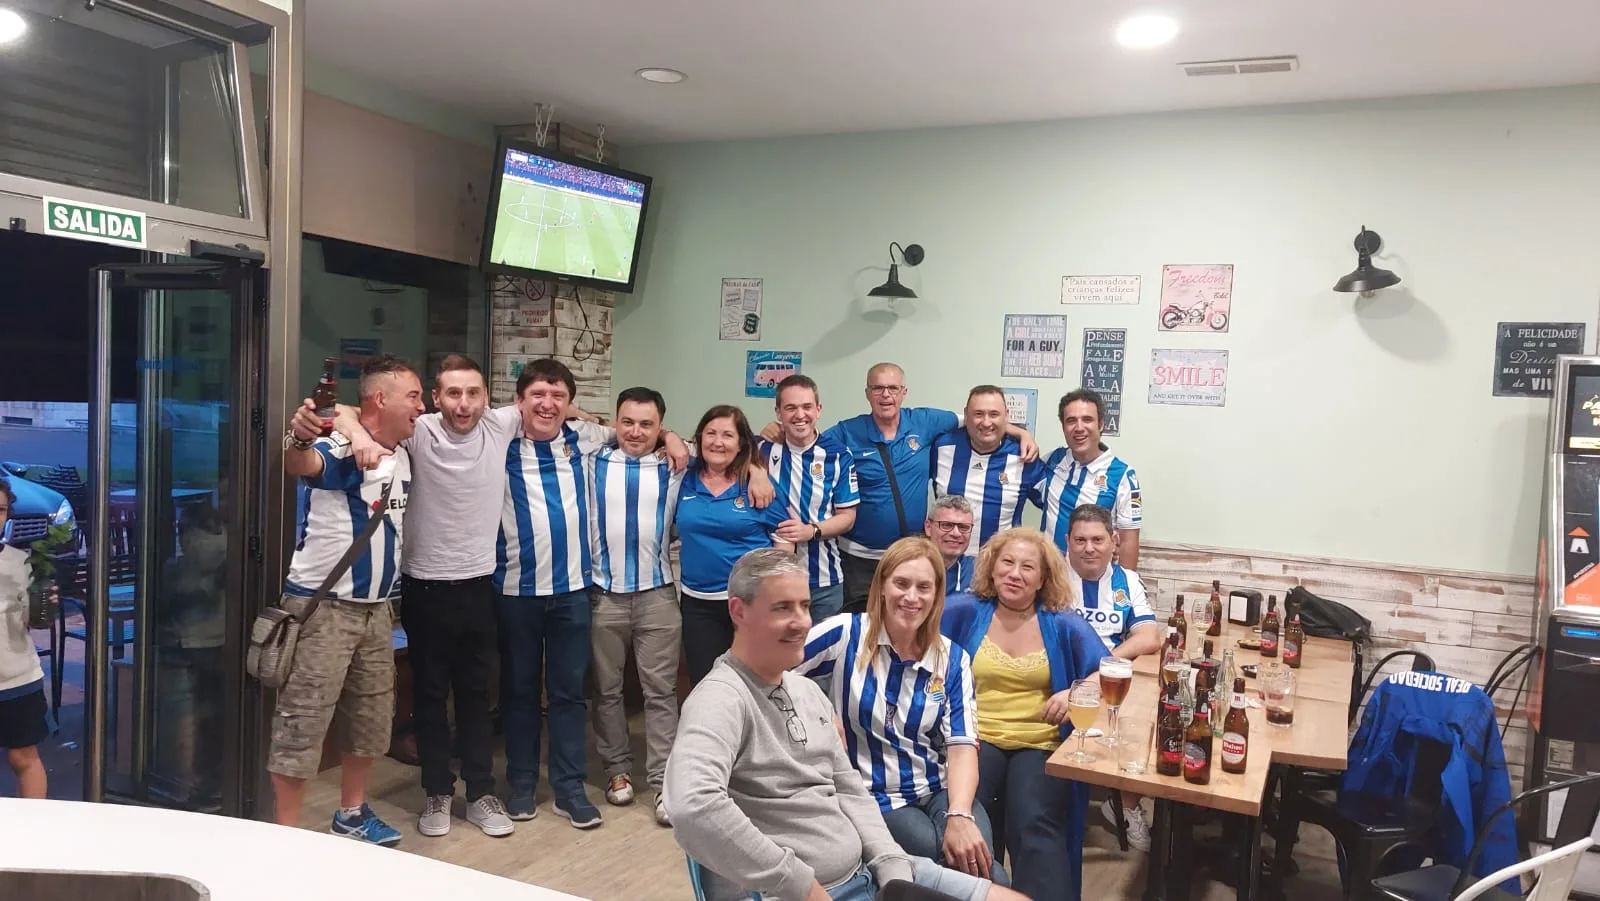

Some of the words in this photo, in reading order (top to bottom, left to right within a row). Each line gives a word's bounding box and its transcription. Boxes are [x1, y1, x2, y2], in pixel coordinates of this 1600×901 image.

[53, 205, 138, 240] SALIDA
[1089, 277, 1128, 286] cansados
[1169, 269, 1226, 288] Freedom
[1086, 331, 1124, 347] PENSE
[1504, 329, 1511, 338] A
[1518, 329, 1578, 339] FELICIDADE
[1006, 339, 1025, 352] FOR
[1028, 340, 1036, 352] A
[1509, 349, 1556, 364] Destin
[1084, 364, 1119, 377] AME
[1153, 365, 1225, 387] SMILE
[1512, 379, 1525, 388] de
